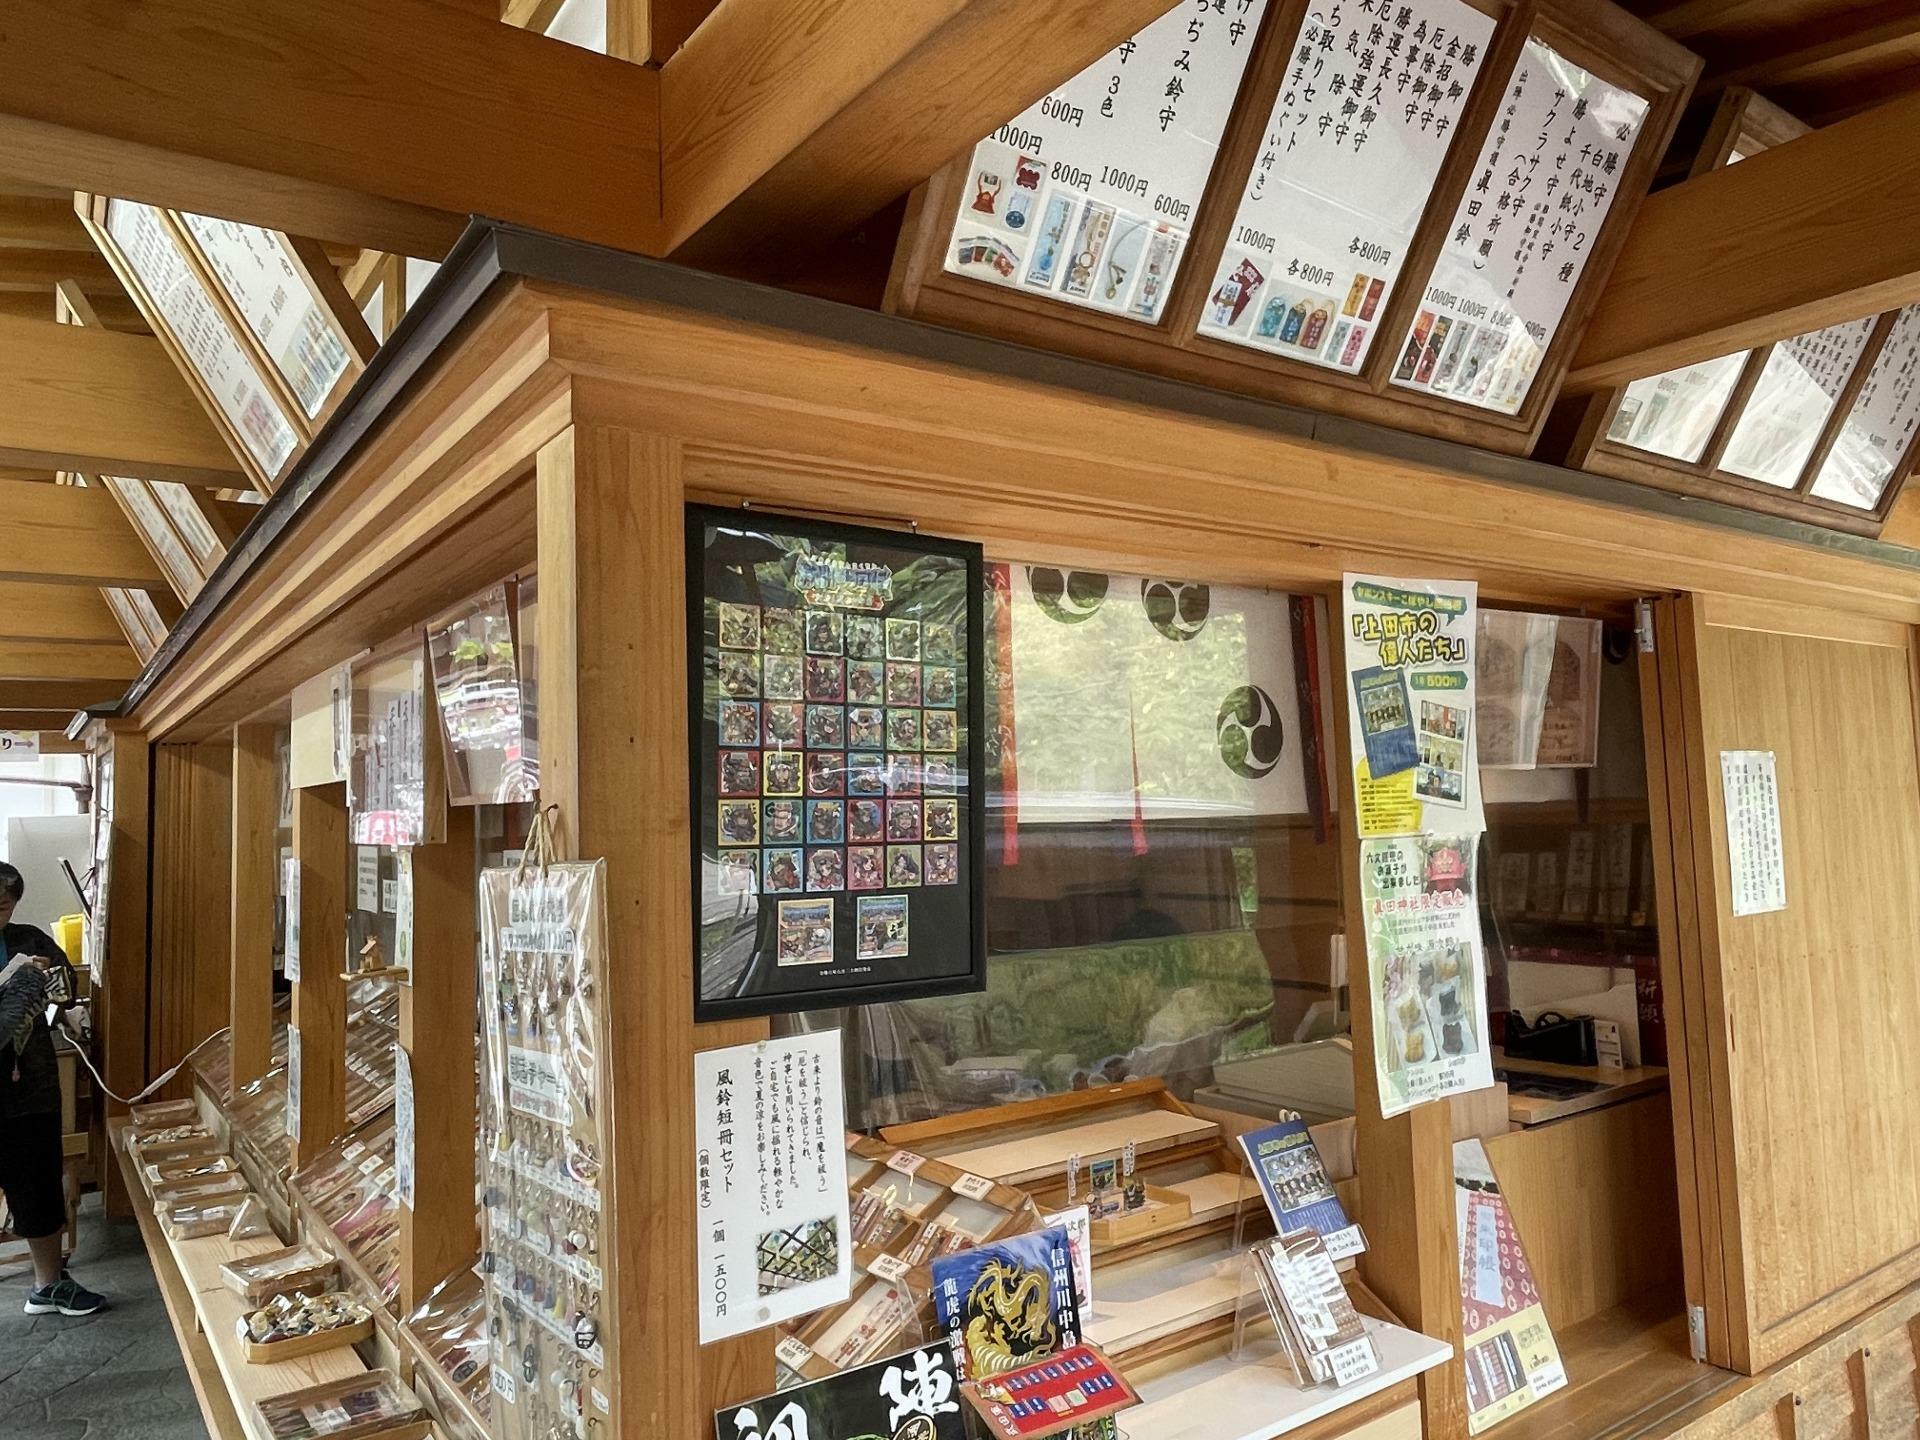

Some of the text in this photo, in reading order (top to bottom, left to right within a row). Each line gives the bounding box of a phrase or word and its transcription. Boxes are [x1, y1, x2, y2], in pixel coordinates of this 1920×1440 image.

[1286, 0, 1346, 153] ち取りセット
[1404, 27, 1445, 124] 厄除御守
[1041, 95, 1084, 128] 600円
[1051, 162, 1092, 192] 800円
[1100, 165, 1149, 197] 1000円
[1154, 194, 1191, 221] 600円
[1236, 225, 1276, 254] 1000円
[1425, 287, 1457, 309] 1000円
[1457, 298, 1488, 320] 1000円
[1352, 611, 1437, 641] 「上田市の
[1380, 637, 1467, 667] 偉人たち」
[716, 1068, 734, 1194] 風鈴短冊セット
[1051, 1248, 1076, 1350] 信州川中島
